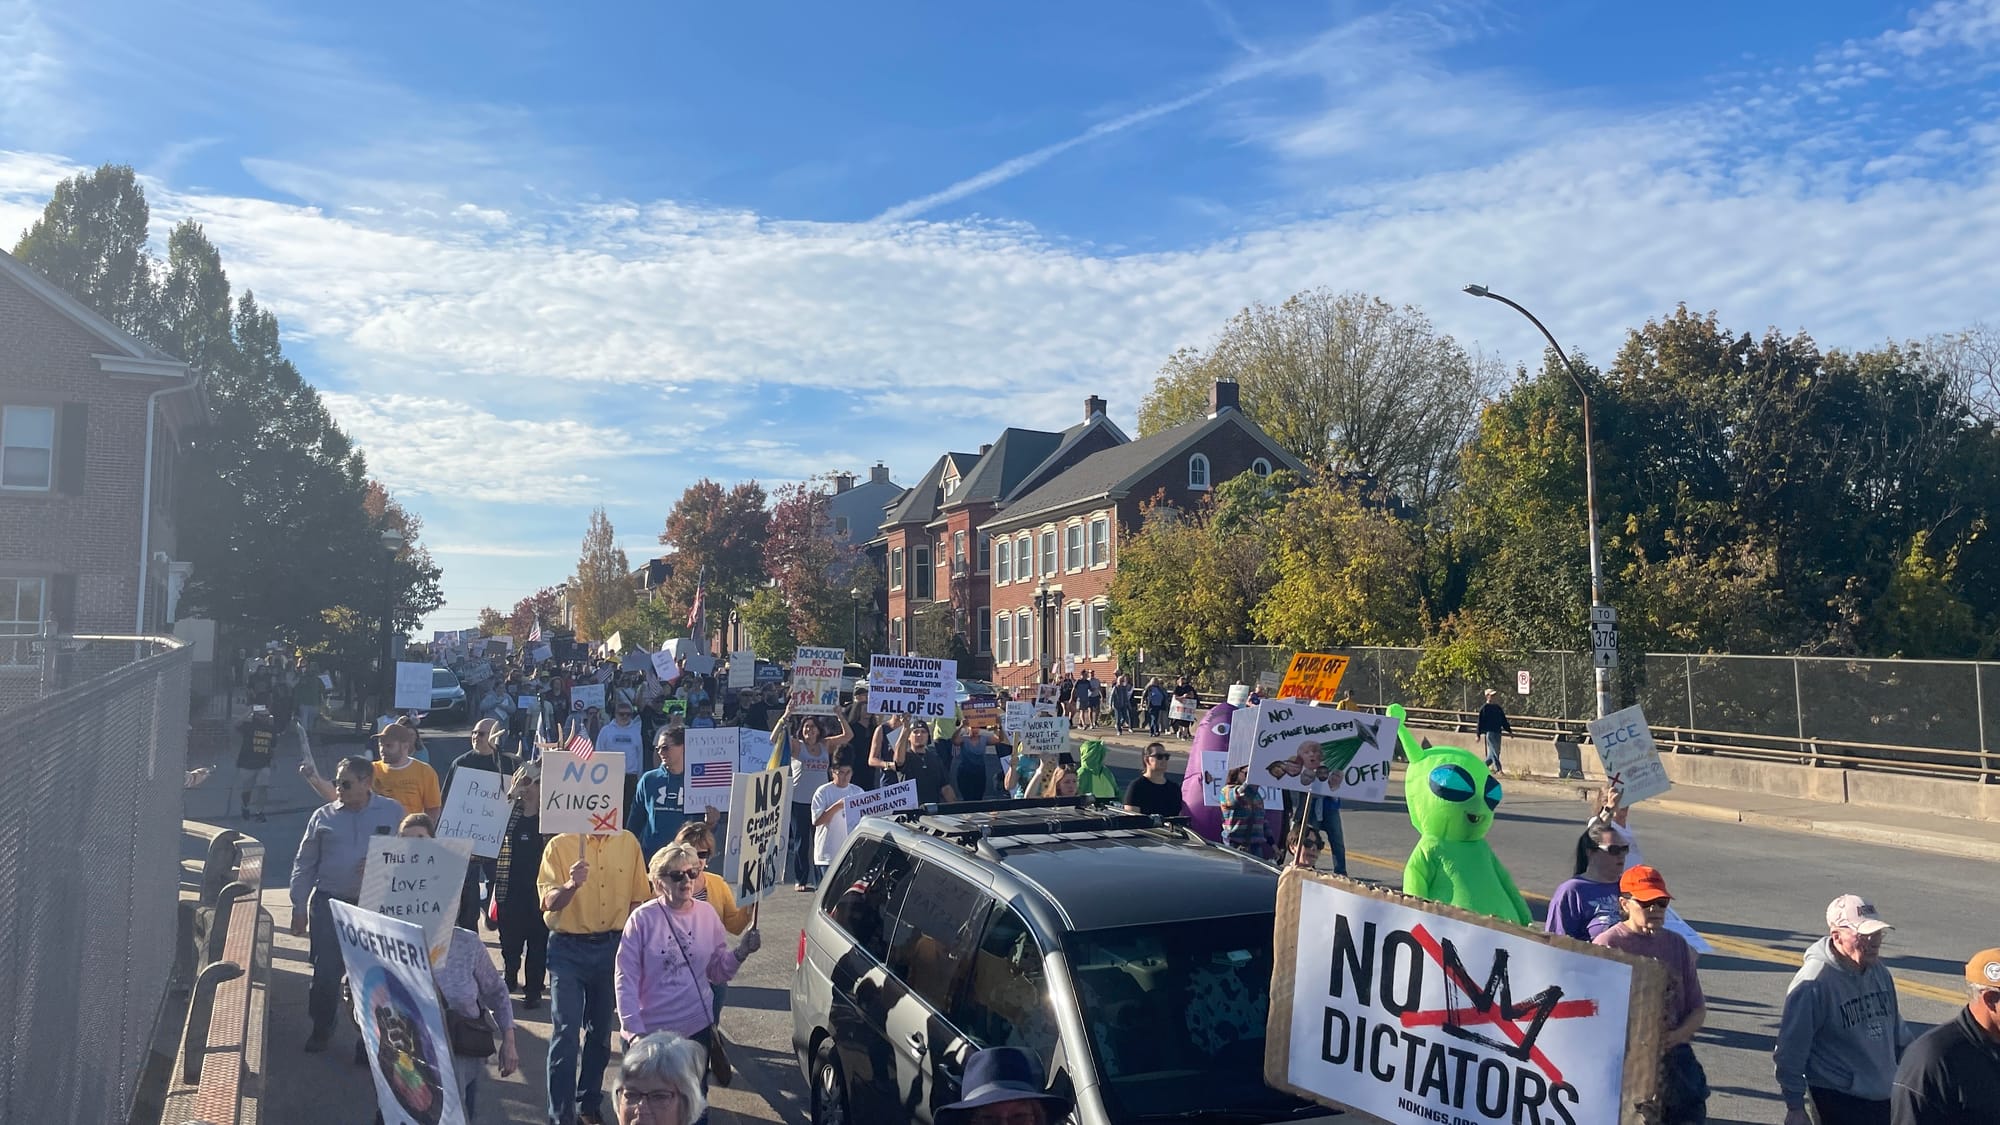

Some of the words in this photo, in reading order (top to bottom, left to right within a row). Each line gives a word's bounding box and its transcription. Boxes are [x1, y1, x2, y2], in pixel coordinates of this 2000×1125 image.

[1598, 610, 1610, 619] TO
[1595, 630, 1616, 648] 378
[873, 656, 942, 671] IMMIGRATION
[1323, 658, 1347, 673] OFF
[899, 679, 918, 687] GREAT
[903, 670, 924, 678] MAKES
[880, 700, 905, 713] ALL
[907, 701, 925, 714] OF
[927, 702, 944, 716] US
[1267, 708, 1295, 723] NO!
[1028, 720, 1054, 730] WORRY
[1258, 730, 1279, 748] GET
[1601, 723, 1641, 749] ICE
[562, 761, 609, 785] NO
[467, 780, 501, 800] Proud
[754, 771, 783, 814] NO
[849, 793, 881, 808] IMAGINE
[883, 784, 910, 798] HATING
[462, 801, 473, 815] to
[482, 804, 495, 817] be
[546, 790, 611, 811] KINGS
[860, 798, 907, 817] IMMIGRANTS
[382, 852, 405, 864] THIS
[411, 854, 419, 864] IS
[427, 855, 435, 864] A
[337, 919, 427, 971] TOGETHER!
[1329, 913, 1424, 1018] NO
[1321, 1006, 1580, 1125] DICTATORS
